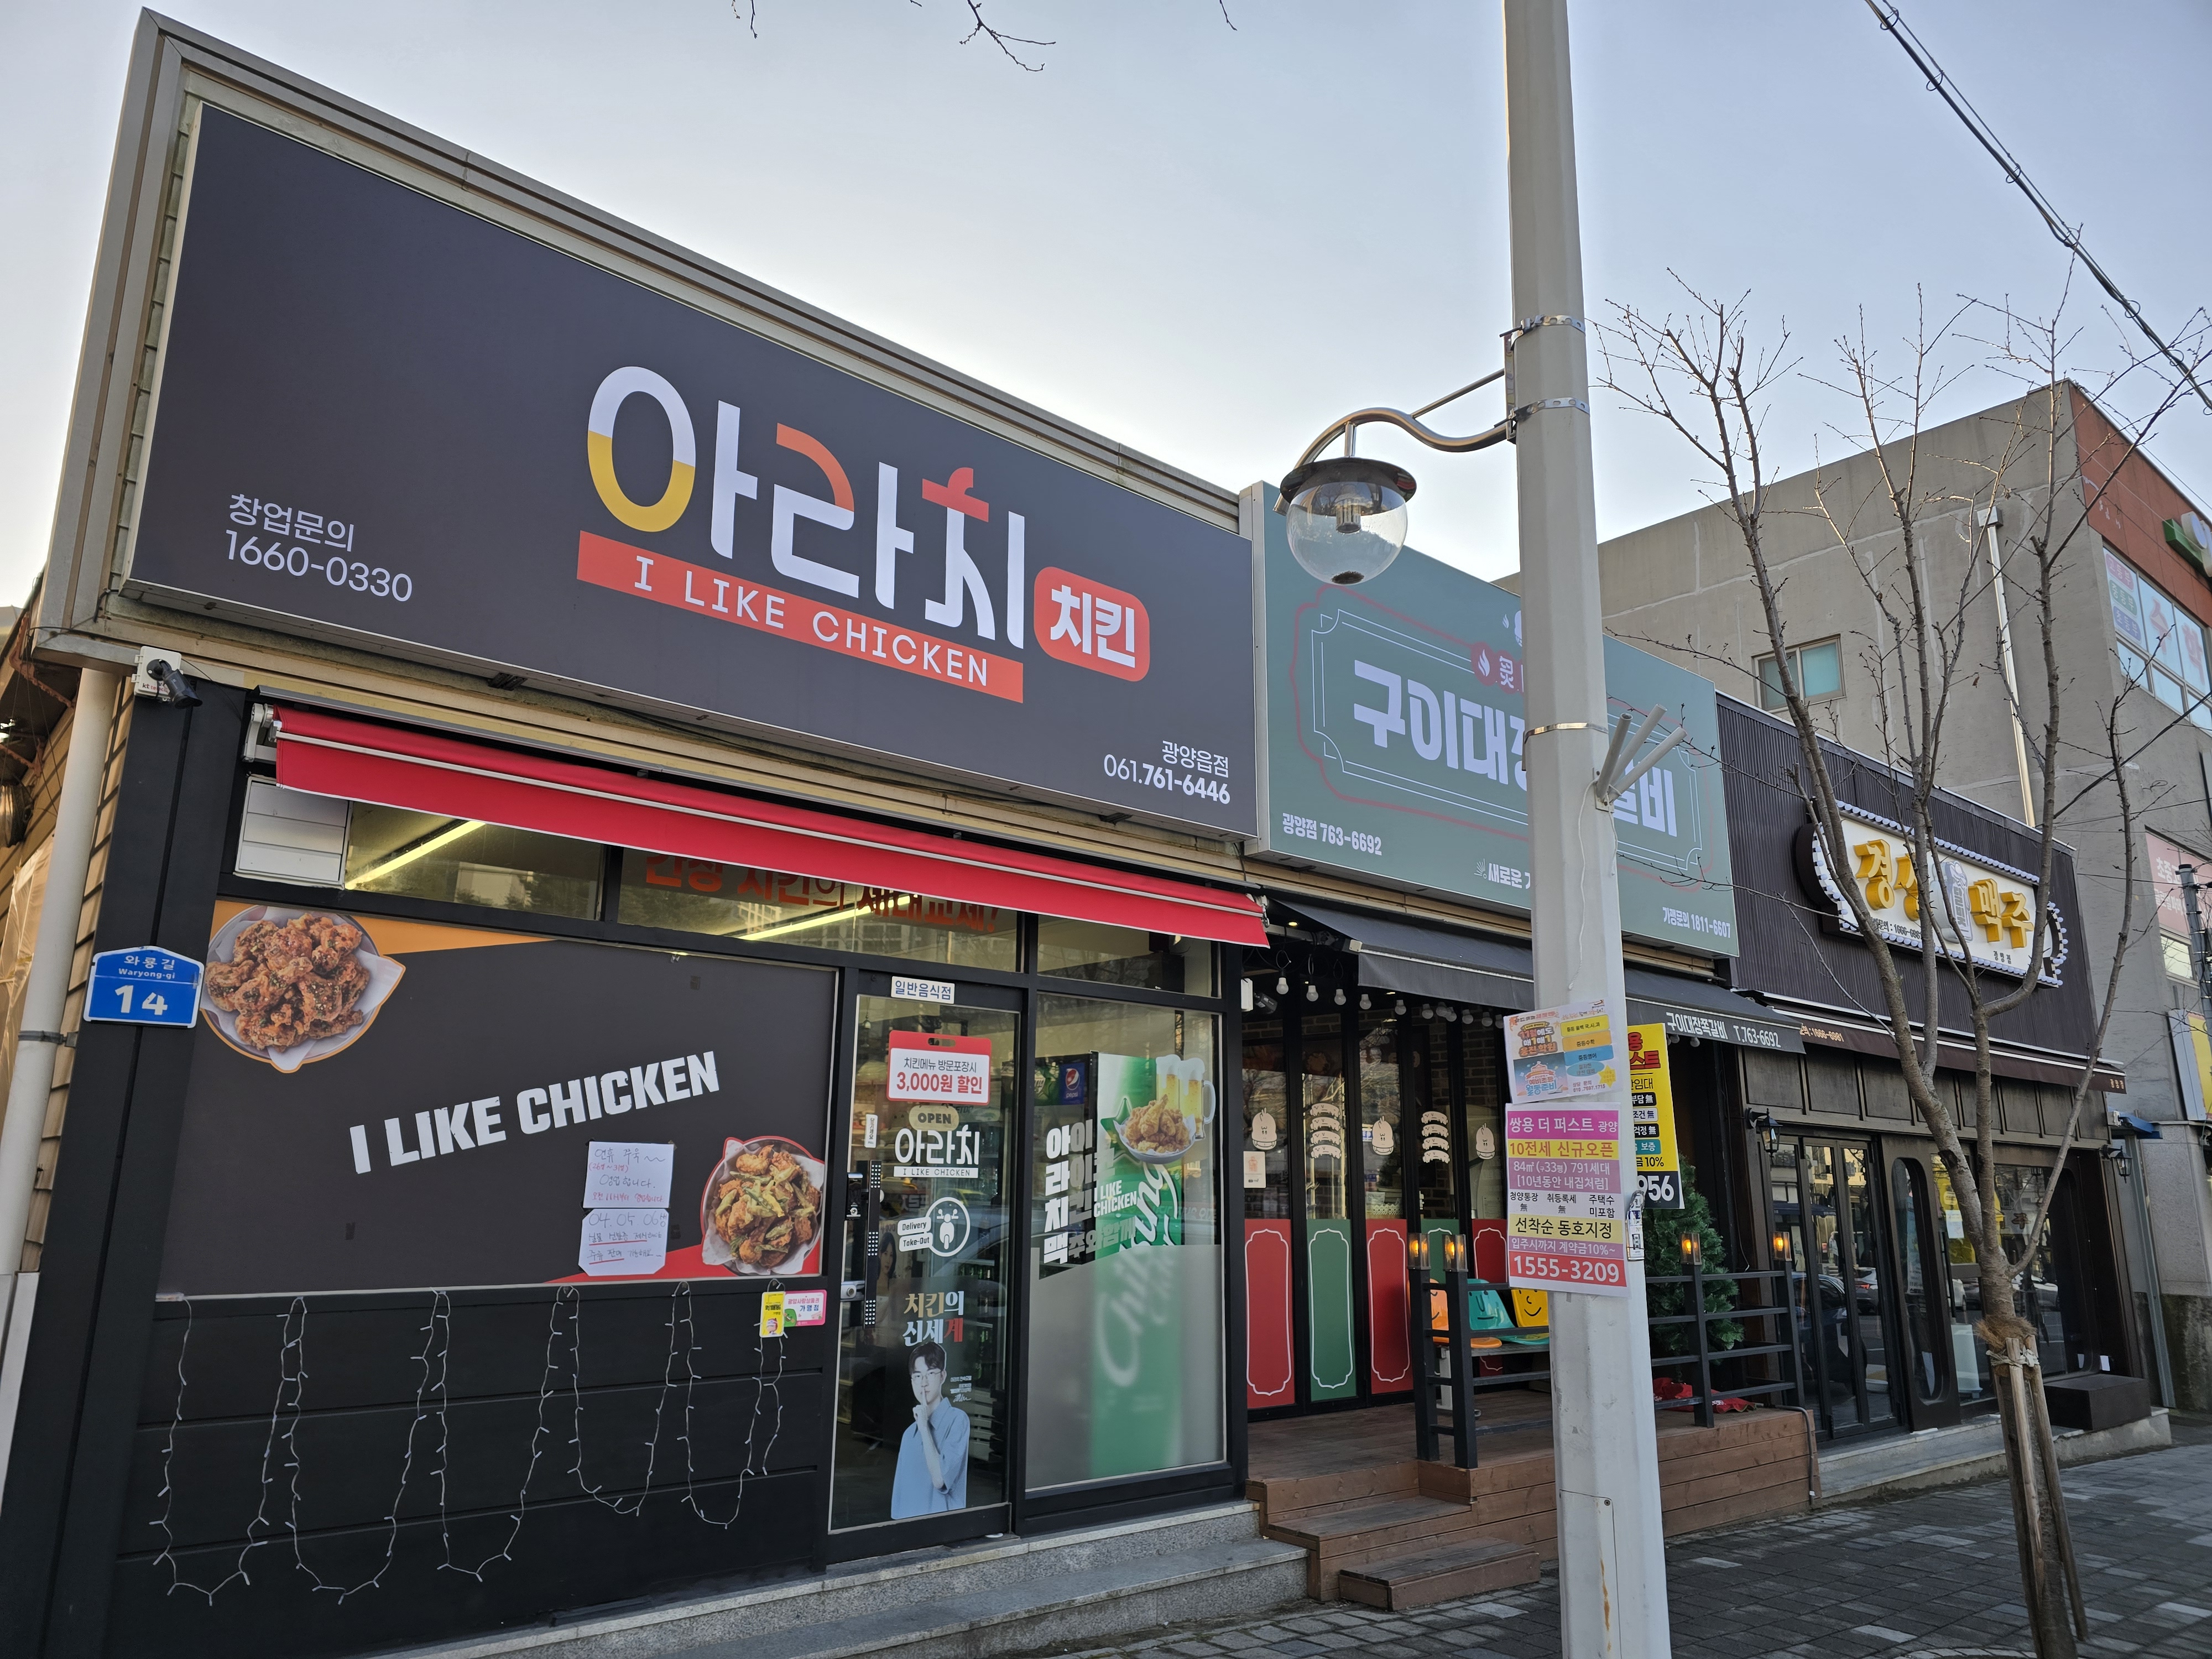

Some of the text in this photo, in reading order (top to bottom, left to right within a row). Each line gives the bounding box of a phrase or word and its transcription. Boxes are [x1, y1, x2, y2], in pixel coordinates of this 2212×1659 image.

[587, 366, 1025, 649] 아라치
[229, 494, 354, 552] 창업문의
[226, 529, 413, 602] 1660-0330
[2109, 557, 2133, 585] 고등부
[2111, 582, 2136, 612] 중등부
[634, 555, 988, 686] I LIKE CHICKEN
[1050, 585, 1136, 669] 치킨
[2115, 608, 2140, 639] 초등부
[1162, 740, 1229, 778] 광양읍점
[1104, 754, 1230, 805] 061.761-6446
[1282, 812, 1383, 856] 광양점 763-6692
[1488, 863, 1522, 889] 새로운
[1662, 906, 1731, 938] 가맹문의 1811-6607
[1968, 878, 2035, 950] 맥주
[123, 954, 175, 971] 와룡길
[114, 984, 168, 1016] 14
[894, 979, 952, 1001] 일반음식점
[1666, 1011, 1729, 1040] 구이대장쪽갈비
[904, 1057, 977, 1073] 치킨메뉴 방문포장시
[896, 1071, 983, 1094] 3,000원 할인
[349, 1051, 720, 1175] I LIKE CHICKEN
[917, 1112, 952, 1124] OPEN
[1509, 1117, 1618, 1134] 쌍용 더 퍼스트 광양
[594, 1147, 614, 1163] 연휴
[895, 1124, 980, 1165] 아라치
[1510, 1141, 1614, 1157] 10전세 신규오픈
[1641, 1142, 1656, 1152] 보증
[911, 1168, 930, 1176] LIKE
[933, 1168, 971, 1177] CHICKEN
[1571, 1162, 1610, 1175] 791세대
[1645, 1156, 1665, 1167] 10%
[1100, 1180, 1122, 1201] LIKE
[1547, 1193, 1577, 1204] 취등록세
[1589, 1194, 1615, 1206] 주택수
[1093, 1191, 1138, 1218] CHICKEN
[1589, 1207, 1615, 1218] 미포함
[902, 1221, 927, 1231] Delivery
[1515, 1217, 1612, 1239] 선착순 동호지정
[903, 1237, 930, 1247] Take-Out
[1511, 1237, 1556, 1252] 입주시까지
[1514, 1255, 1619, 1283] 1555-3209
[903, 1291, 964, 1318] 치킨의
[902, 1317, 963, 1347] 신세계
